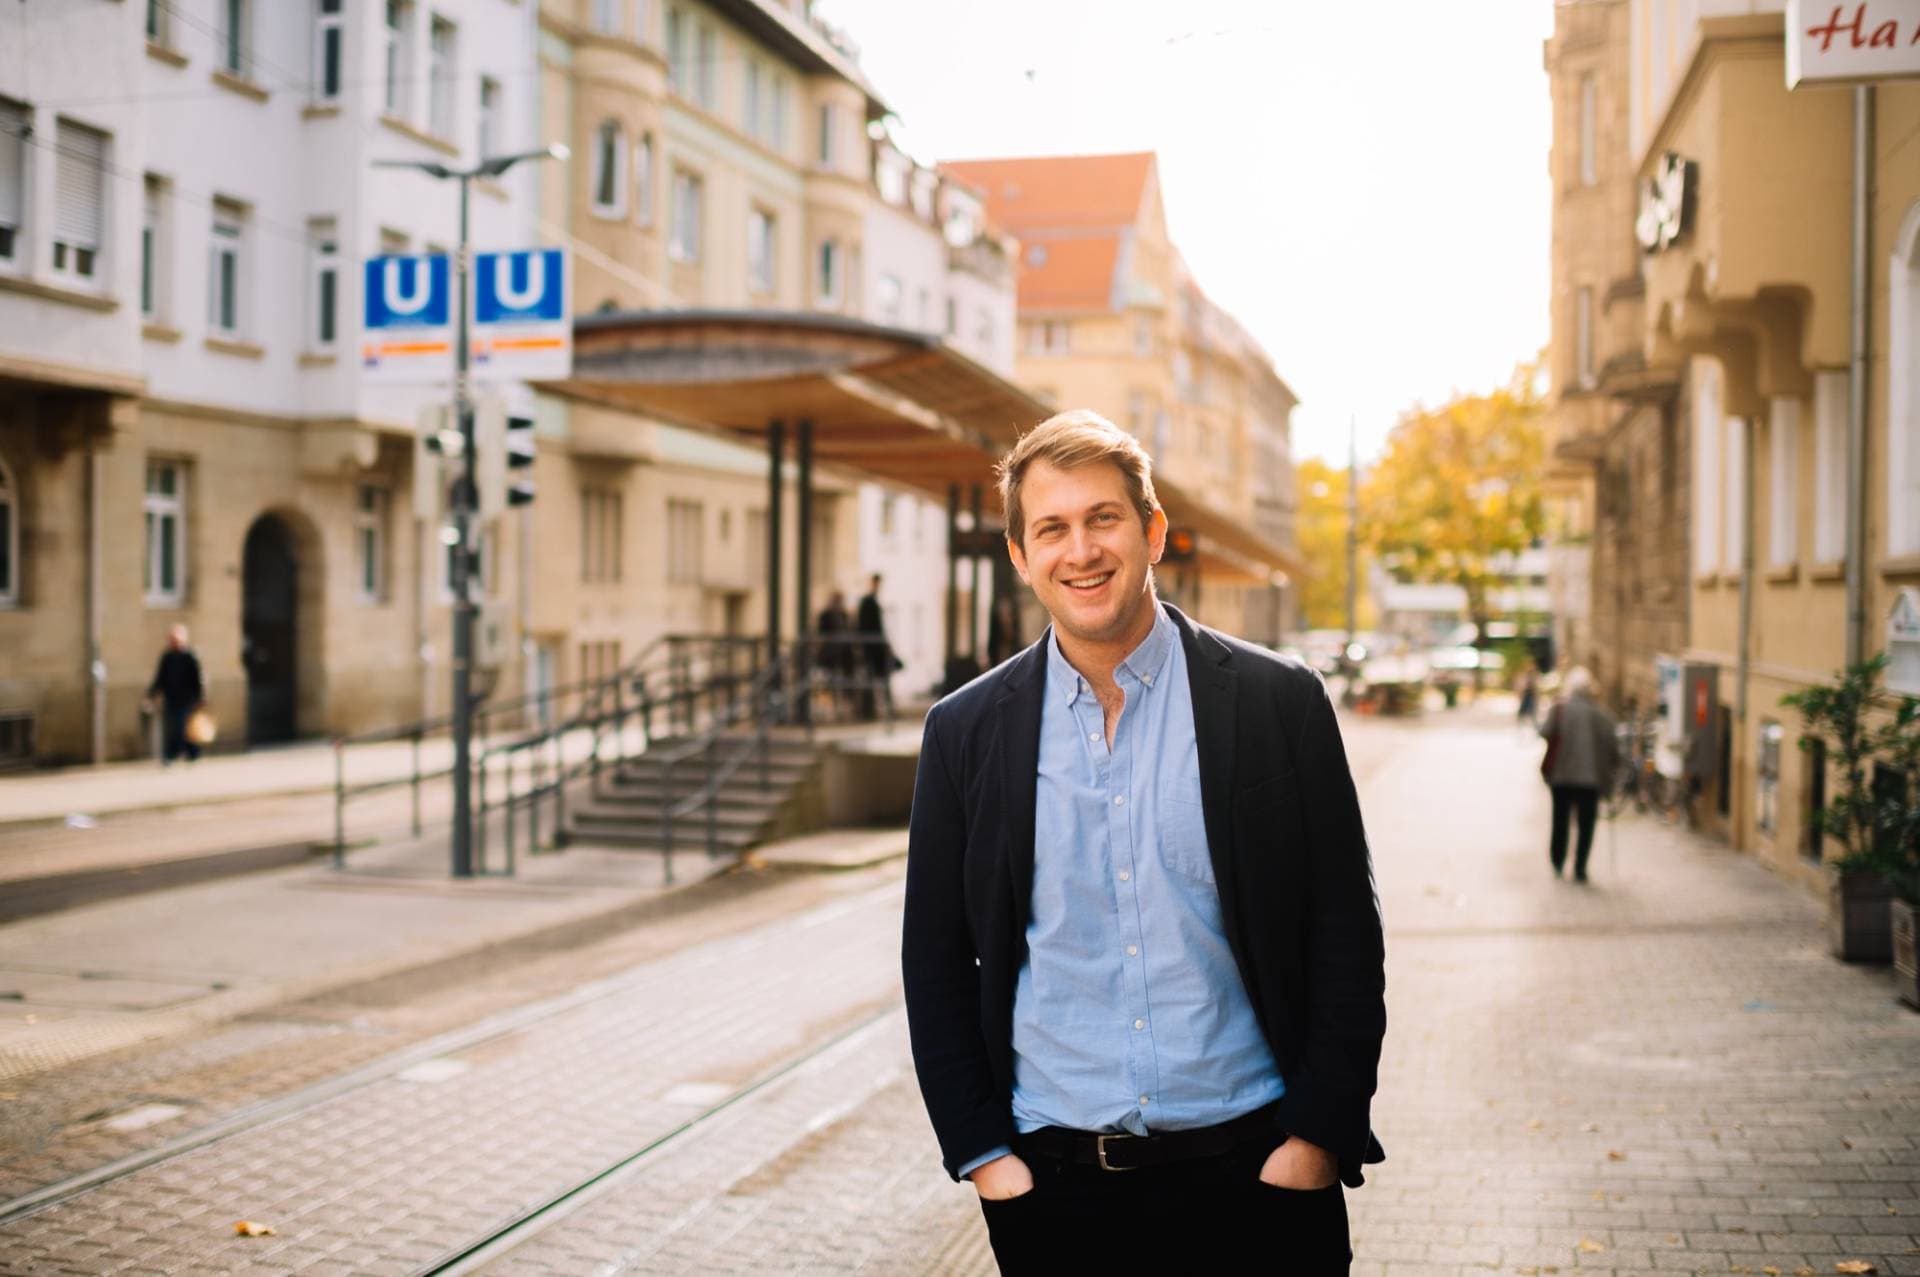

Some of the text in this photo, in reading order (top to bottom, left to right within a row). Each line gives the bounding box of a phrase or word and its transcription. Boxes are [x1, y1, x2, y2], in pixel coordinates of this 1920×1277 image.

[1806, 2, 1920, 52] Ha
[383, 257, 431, 315] U
[493, 253, 545, 310] U
